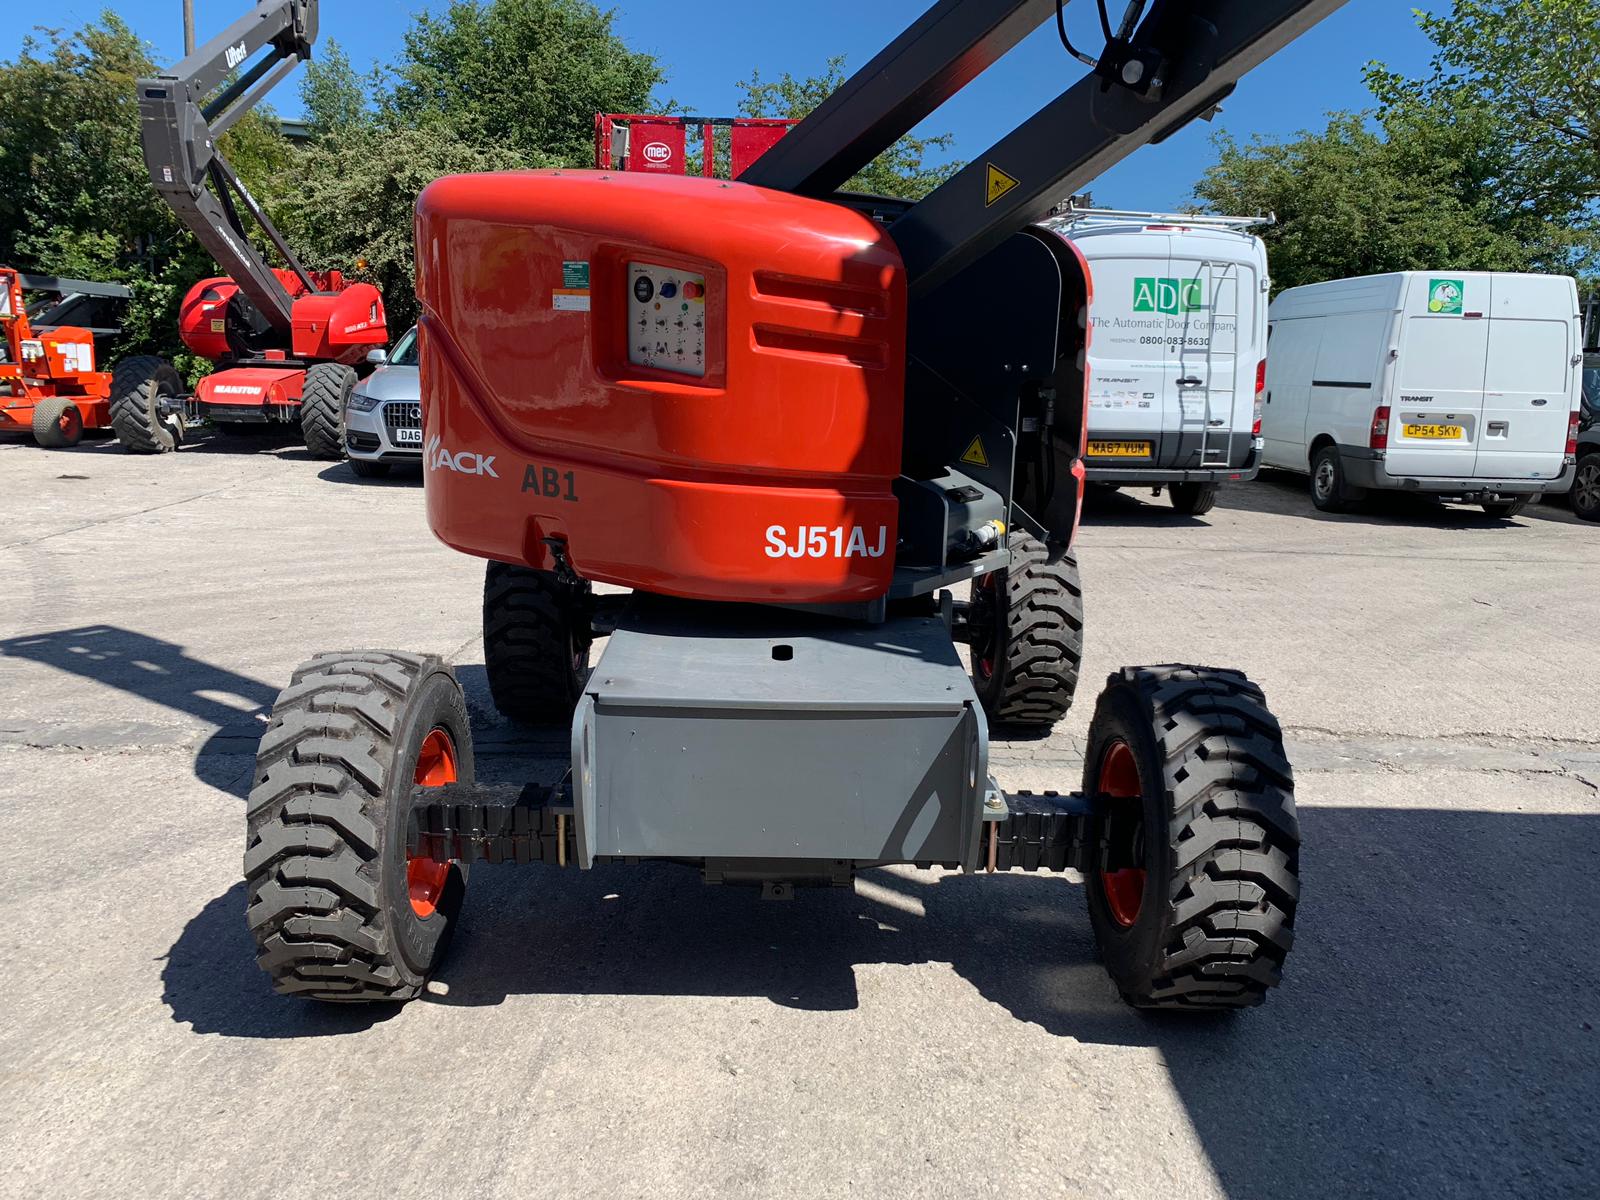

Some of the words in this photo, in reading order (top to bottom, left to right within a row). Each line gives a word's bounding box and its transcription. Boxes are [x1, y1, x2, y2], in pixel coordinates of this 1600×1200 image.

[647, 147, 667, 158] mec
[1134, 282, 1200, 310] ADC
[1091, 317, 1110, 329] The
[1112, 317, 1163, 330] Automatic
[1166, 318, 1191, 331] Door
[1139, 336, 1209, 347] 0800-083-8630
[213, 385, 262, 395] MANITOU
[401, 430, 421, 441] DA6
[1407, 425, 1435, 436] CP54
[1438, 425, 1458, 436] SKY
[1092, 442, 1120, 454] MA67
[1124, 442, 1145, 454] VUM
[521, 463, 579, 502] AB1
[765, 525, 887, 558] SJ51AJ
